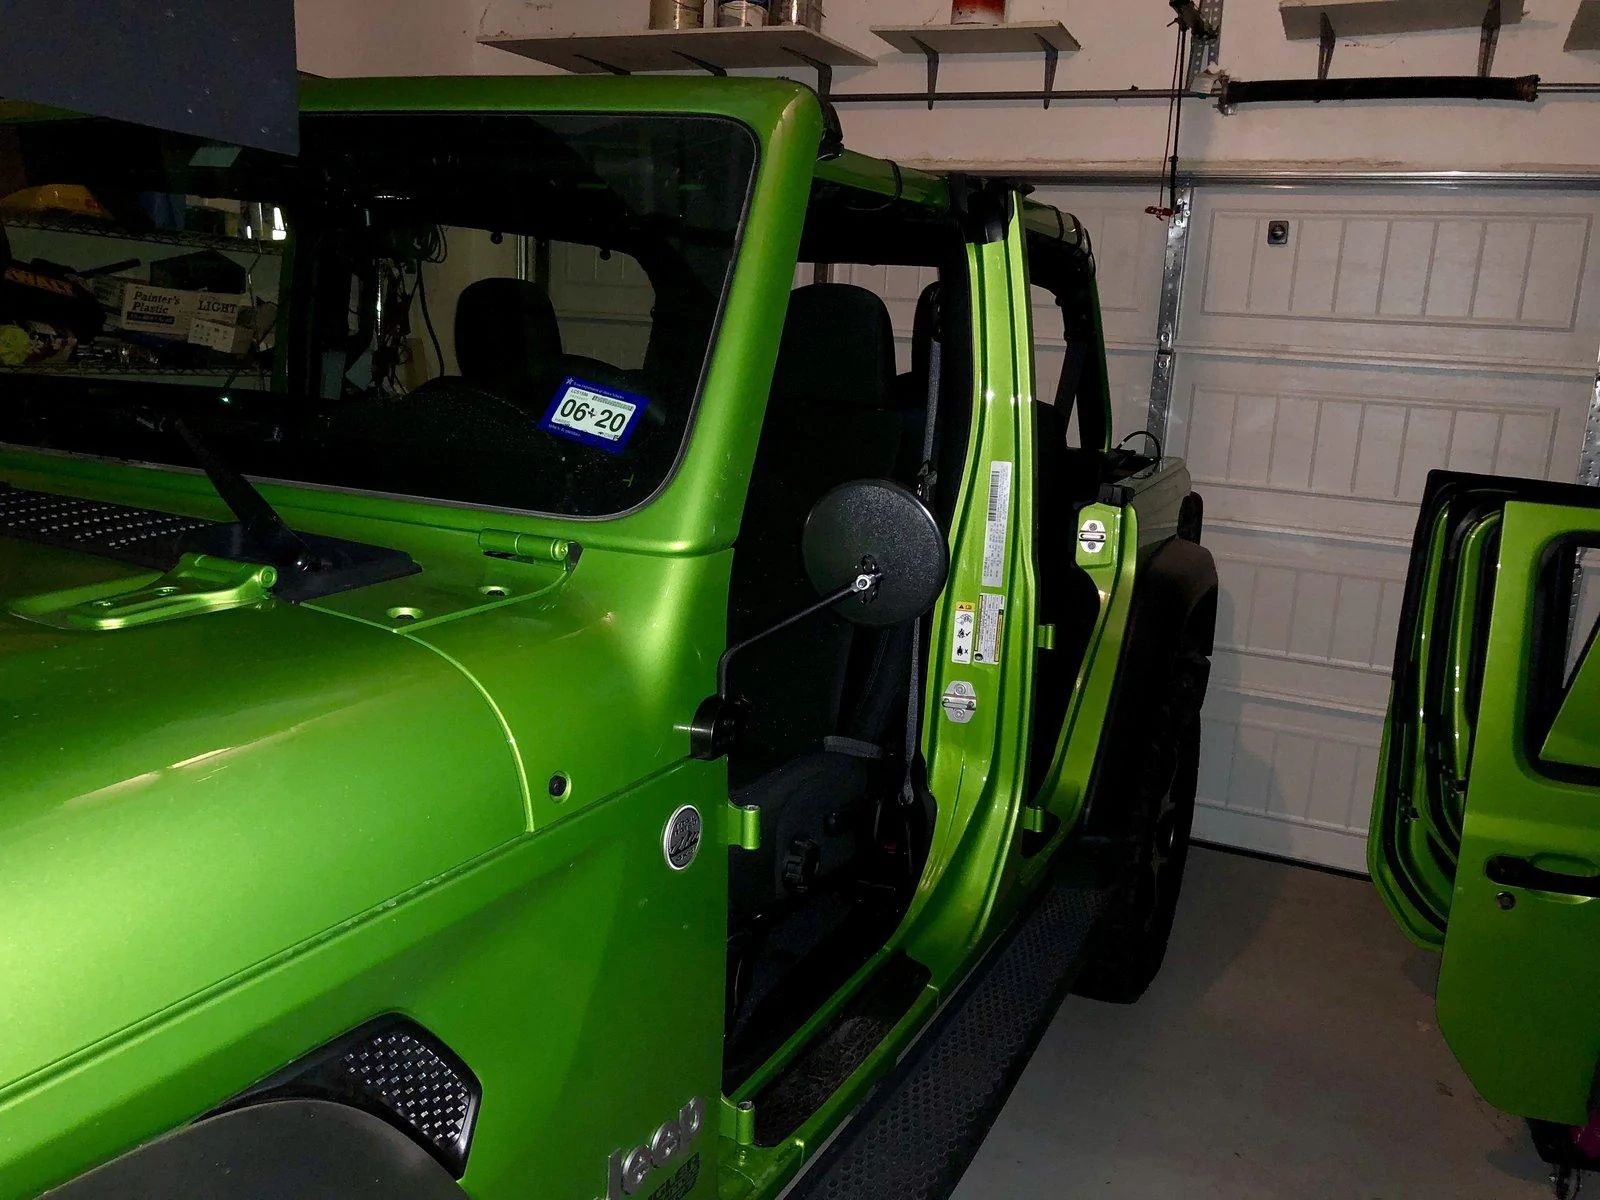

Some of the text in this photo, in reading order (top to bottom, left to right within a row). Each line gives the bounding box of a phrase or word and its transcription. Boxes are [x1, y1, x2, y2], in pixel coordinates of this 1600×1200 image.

[133, 290, 180, 306] Painter's
[132, 301, 169, 314] Plastic
[198, 300, 237, 314] LIGHT
[560, 398, 590, 422] 06
[594, 409, 626, 433] 20
[592, 1096, 708, 1200] Jeep
